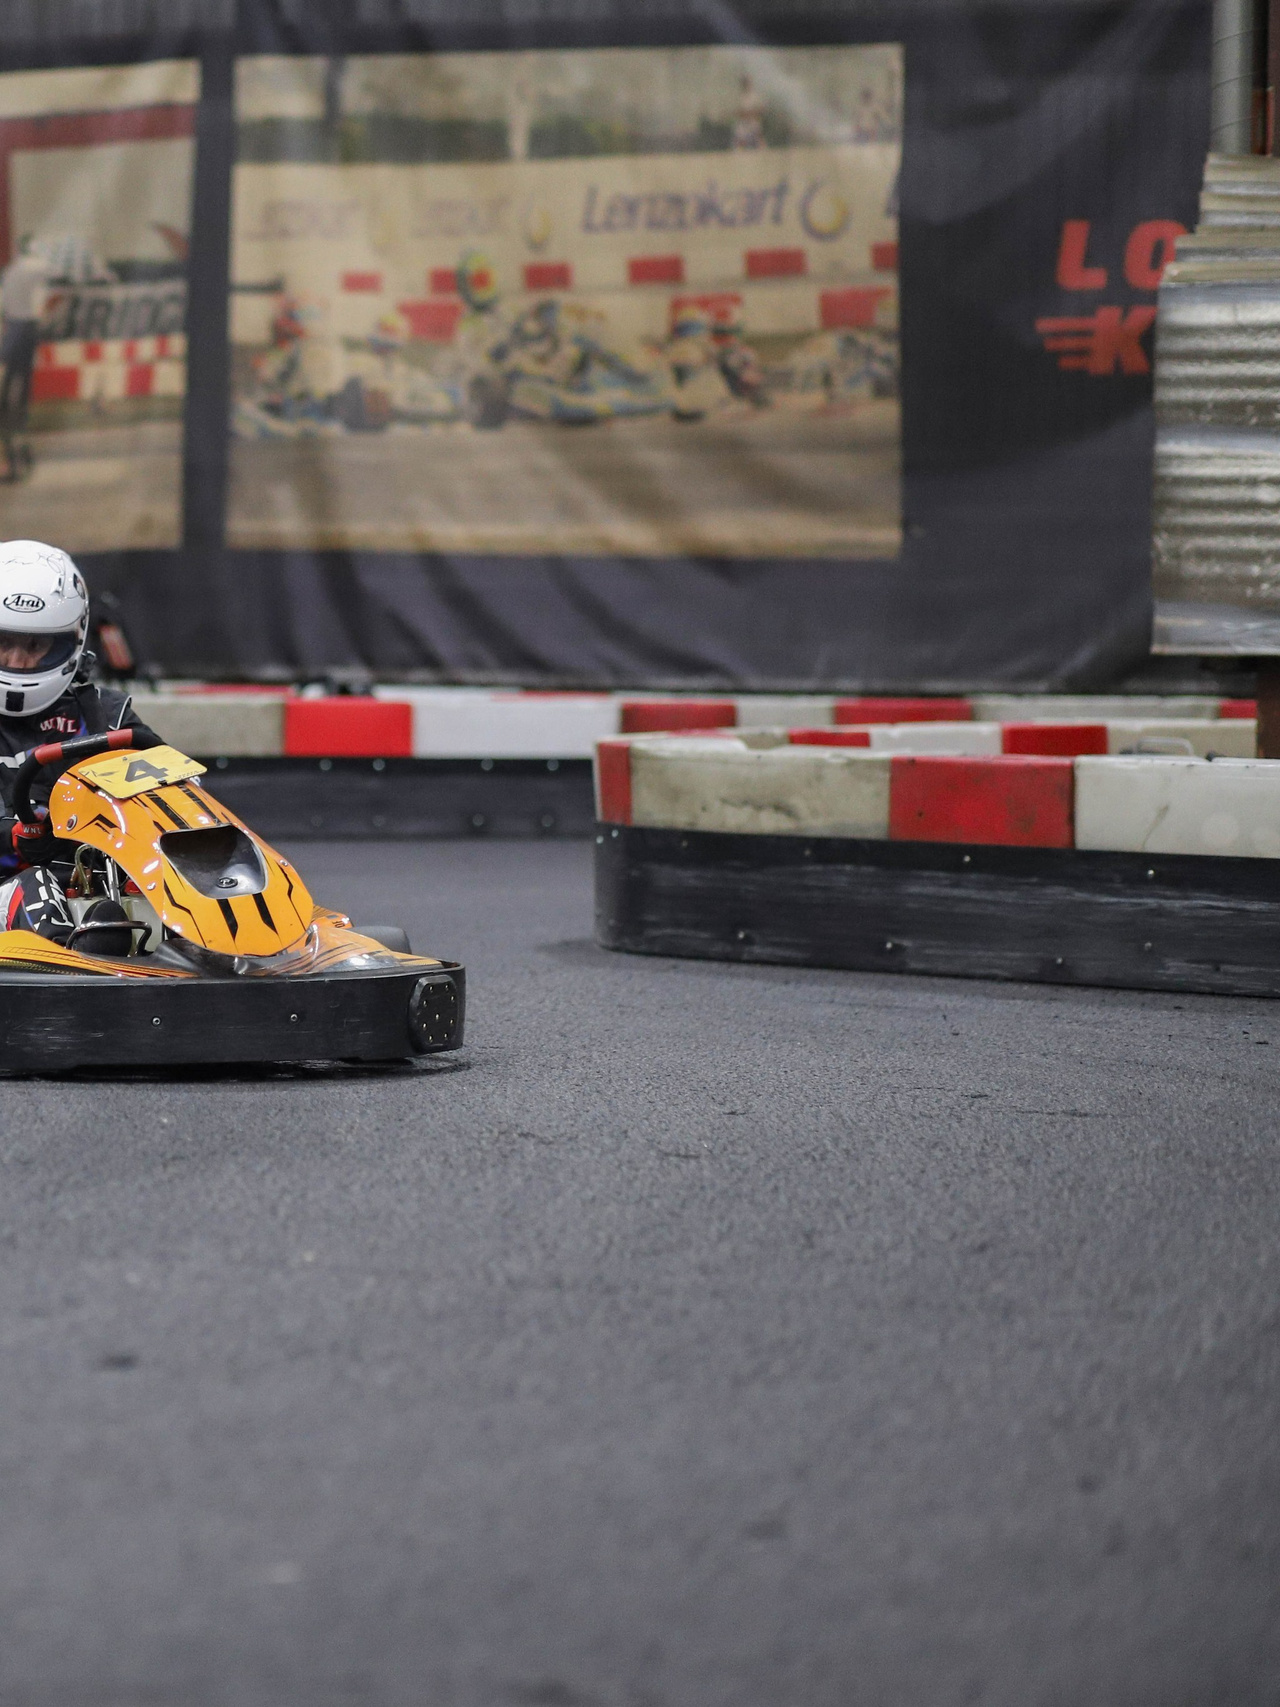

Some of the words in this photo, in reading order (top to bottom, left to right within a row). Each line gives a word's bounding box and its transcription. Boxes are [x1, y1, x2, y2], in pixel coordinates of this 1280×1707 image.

[5, 594, 41, 608] Arai
[39, 716, 77, 733] WNL
[124, 759, 169, 783] 4
